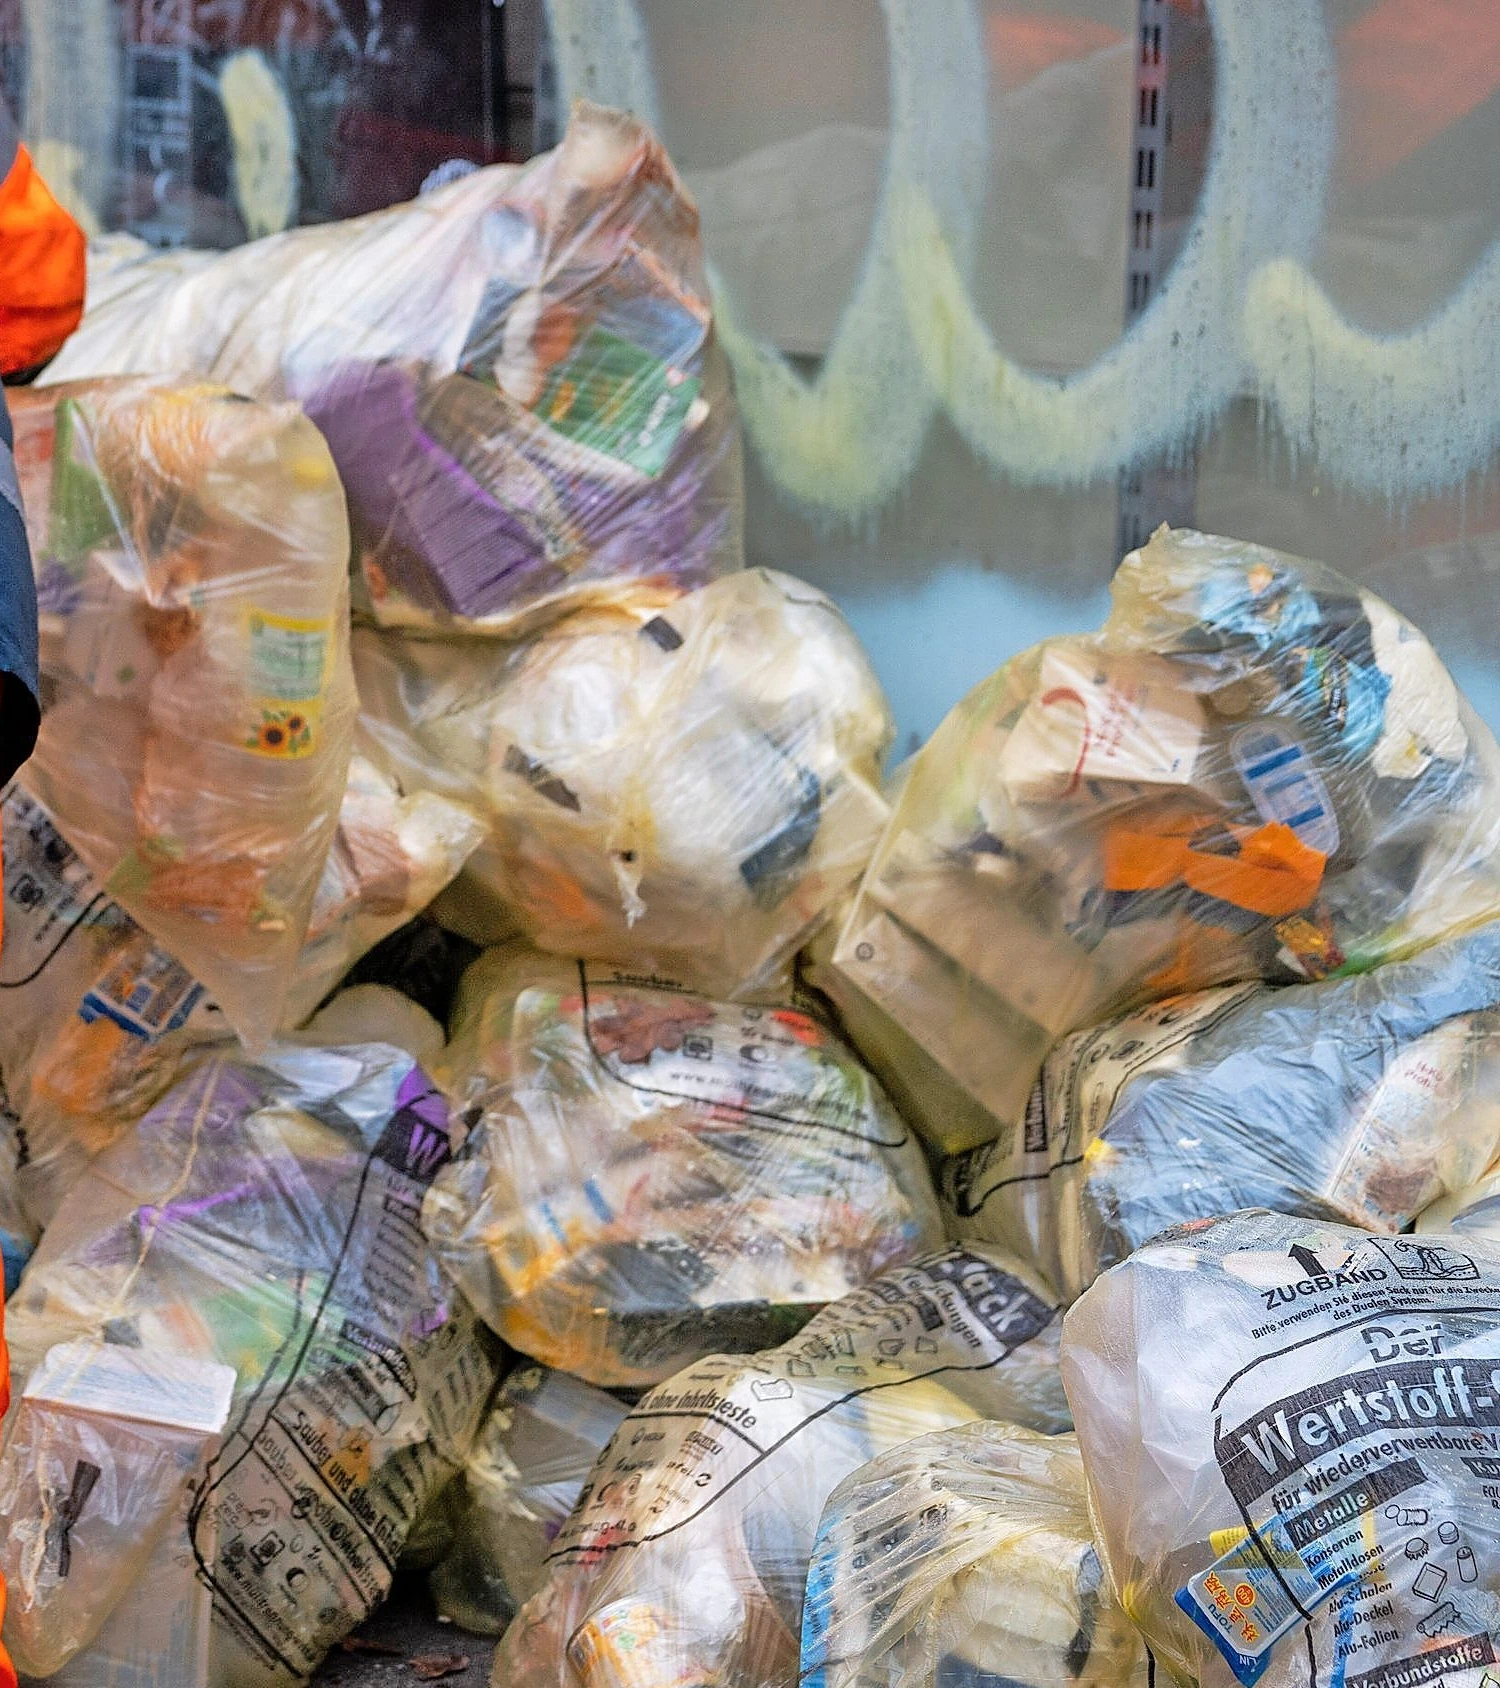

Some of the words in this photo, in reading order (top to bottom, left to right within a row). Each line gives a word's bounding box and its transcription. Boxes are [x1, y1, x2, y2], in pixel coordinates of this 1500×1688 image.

[1260, 1268, 1388, 1311] ZUGBAND
[1278, 1302, 1333, 1329] verwenden
[1351, 1287, 1387, 1302] diesen
[1386, 1285, 1410, 1296] Sack
[1333, 1308, 1352, 1322] des
[1352, 1298, 1390, 1313] Dualen
[1360, 1322, 1446, 1365] Der
[1270, 1488, 1301, 1515] für
[1302, 1431, 1484, 1496] wiederverwertbare
[1292, 1491, 1370, 1541] Metalle
[1304, 1530, 1365, 1570] Konserven
[1317, 1543, 1386, 1591] Metalldosen
[1207, 1603, 1234, 1633] TOFU
[1328, 1581, 1394, 1616] Alu-Schalen
[1333, 1600, 1395, 1638] Alu-Deckel
[1338, 1629, 1400, 1660] Alu-Folien
